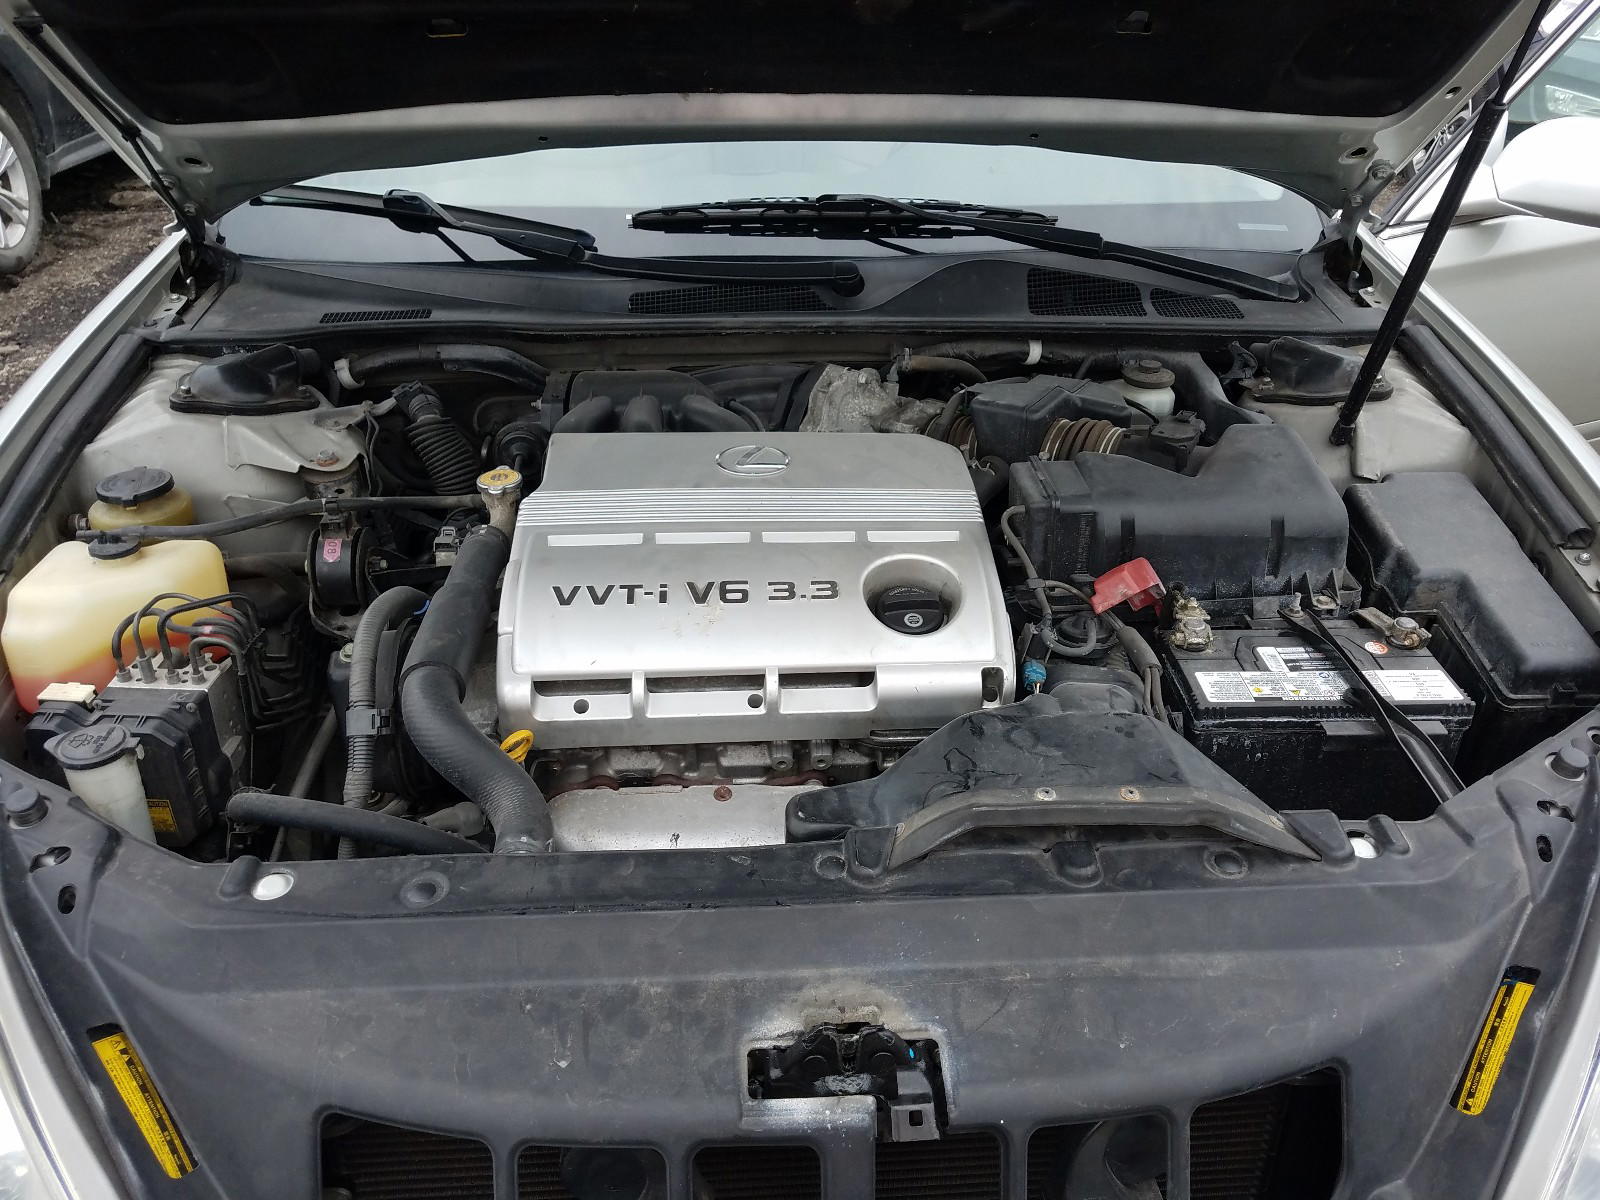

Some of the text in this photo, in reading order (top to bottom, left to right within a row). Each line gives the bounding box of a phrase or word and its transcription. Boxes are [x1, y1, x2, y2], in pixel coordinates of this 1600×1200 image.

[552, 580, 840, 606] VVT-i V6 3.3
[129, 1064, 143, 1085] CAUTION
[145, 1092, 160, 1119] ATTENTION
[1470, 1071, 1481, 1093] CAUTION
[1480, 1038, 1493, 1064] ATTENTION
